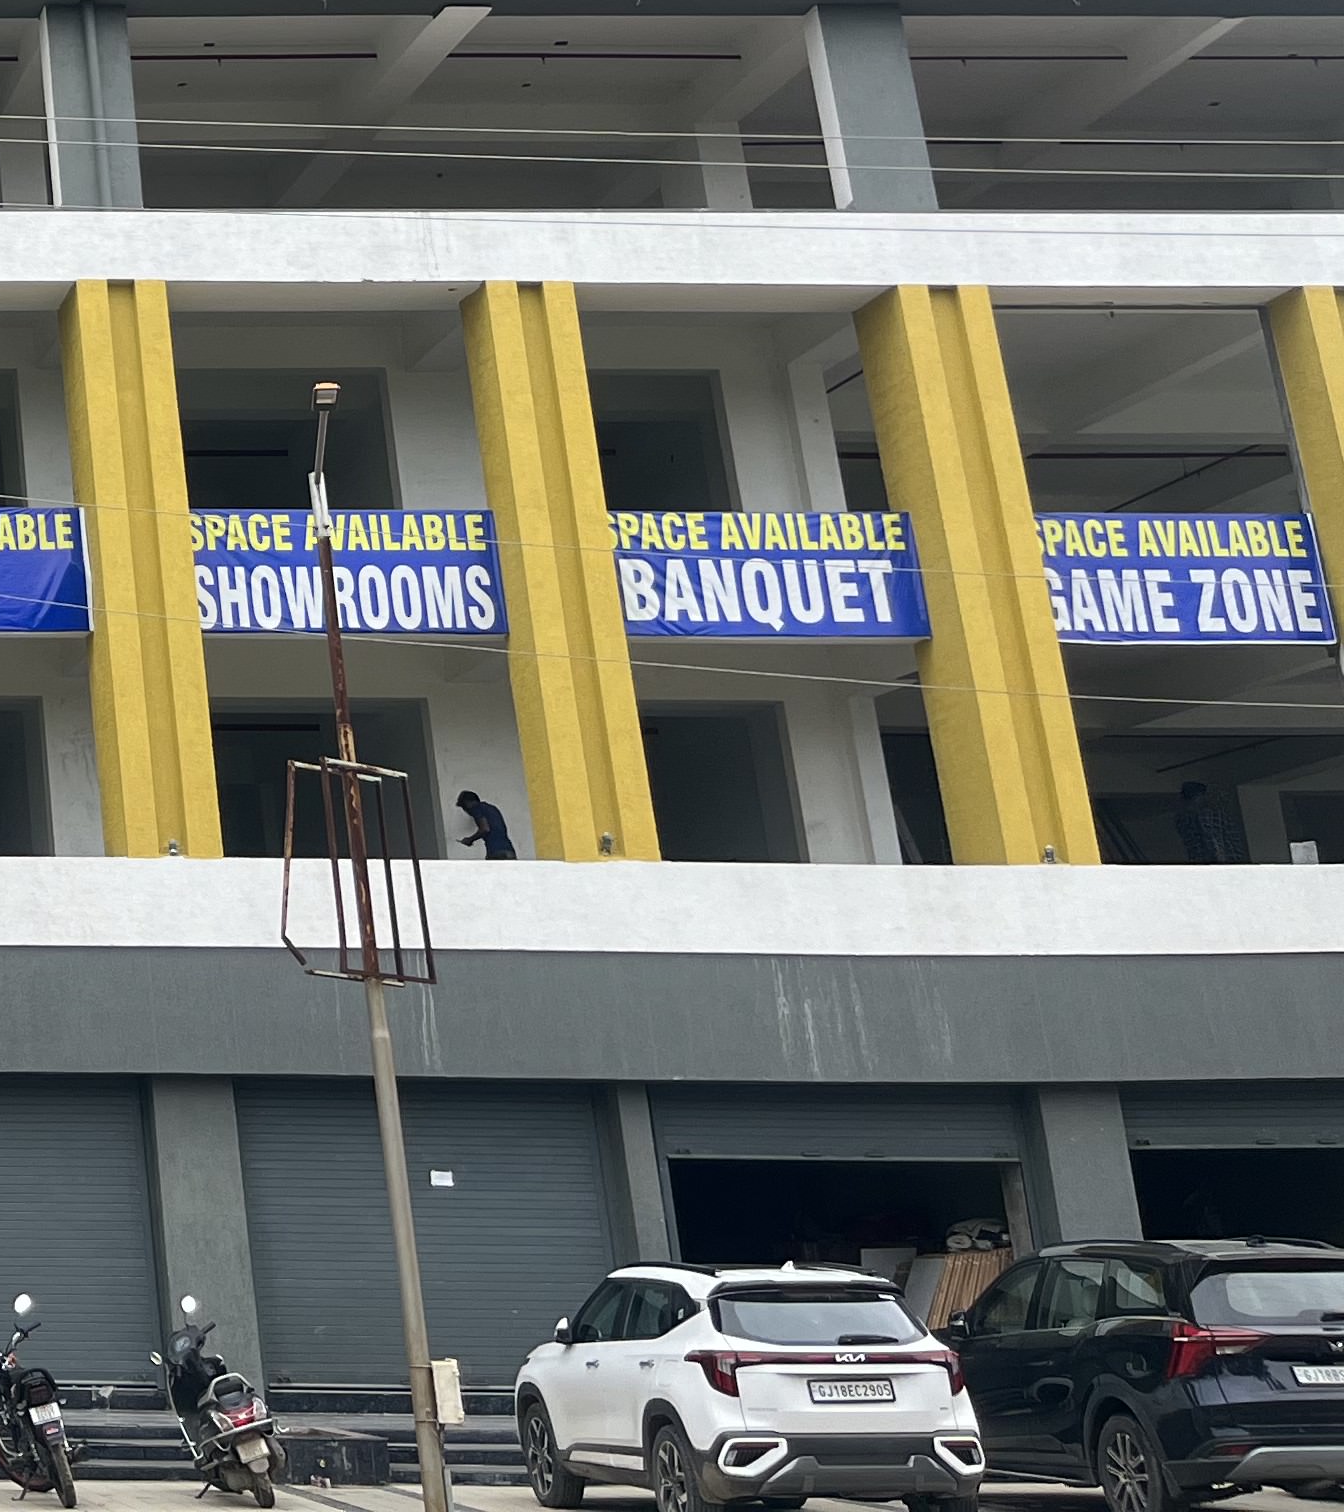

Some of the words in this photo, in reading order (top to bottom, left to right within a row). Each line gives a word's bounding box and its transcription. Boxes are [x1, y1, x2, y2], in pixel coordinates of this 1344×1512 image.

[189, 513, 293, 552] SPACE
[305, 513, 487, 551] AVAILABLE
[720, 512, 907, 551] AVAILABLE
[1034, 519, 1129, 557] PACE
[1139, 519, 1307, 559] AVAILABLE
[194, 564, 497, 630] SHOWROOMS
[618, 558, 893, 631] BANQUET
[1190, 568, 1322, 633] ZONE
